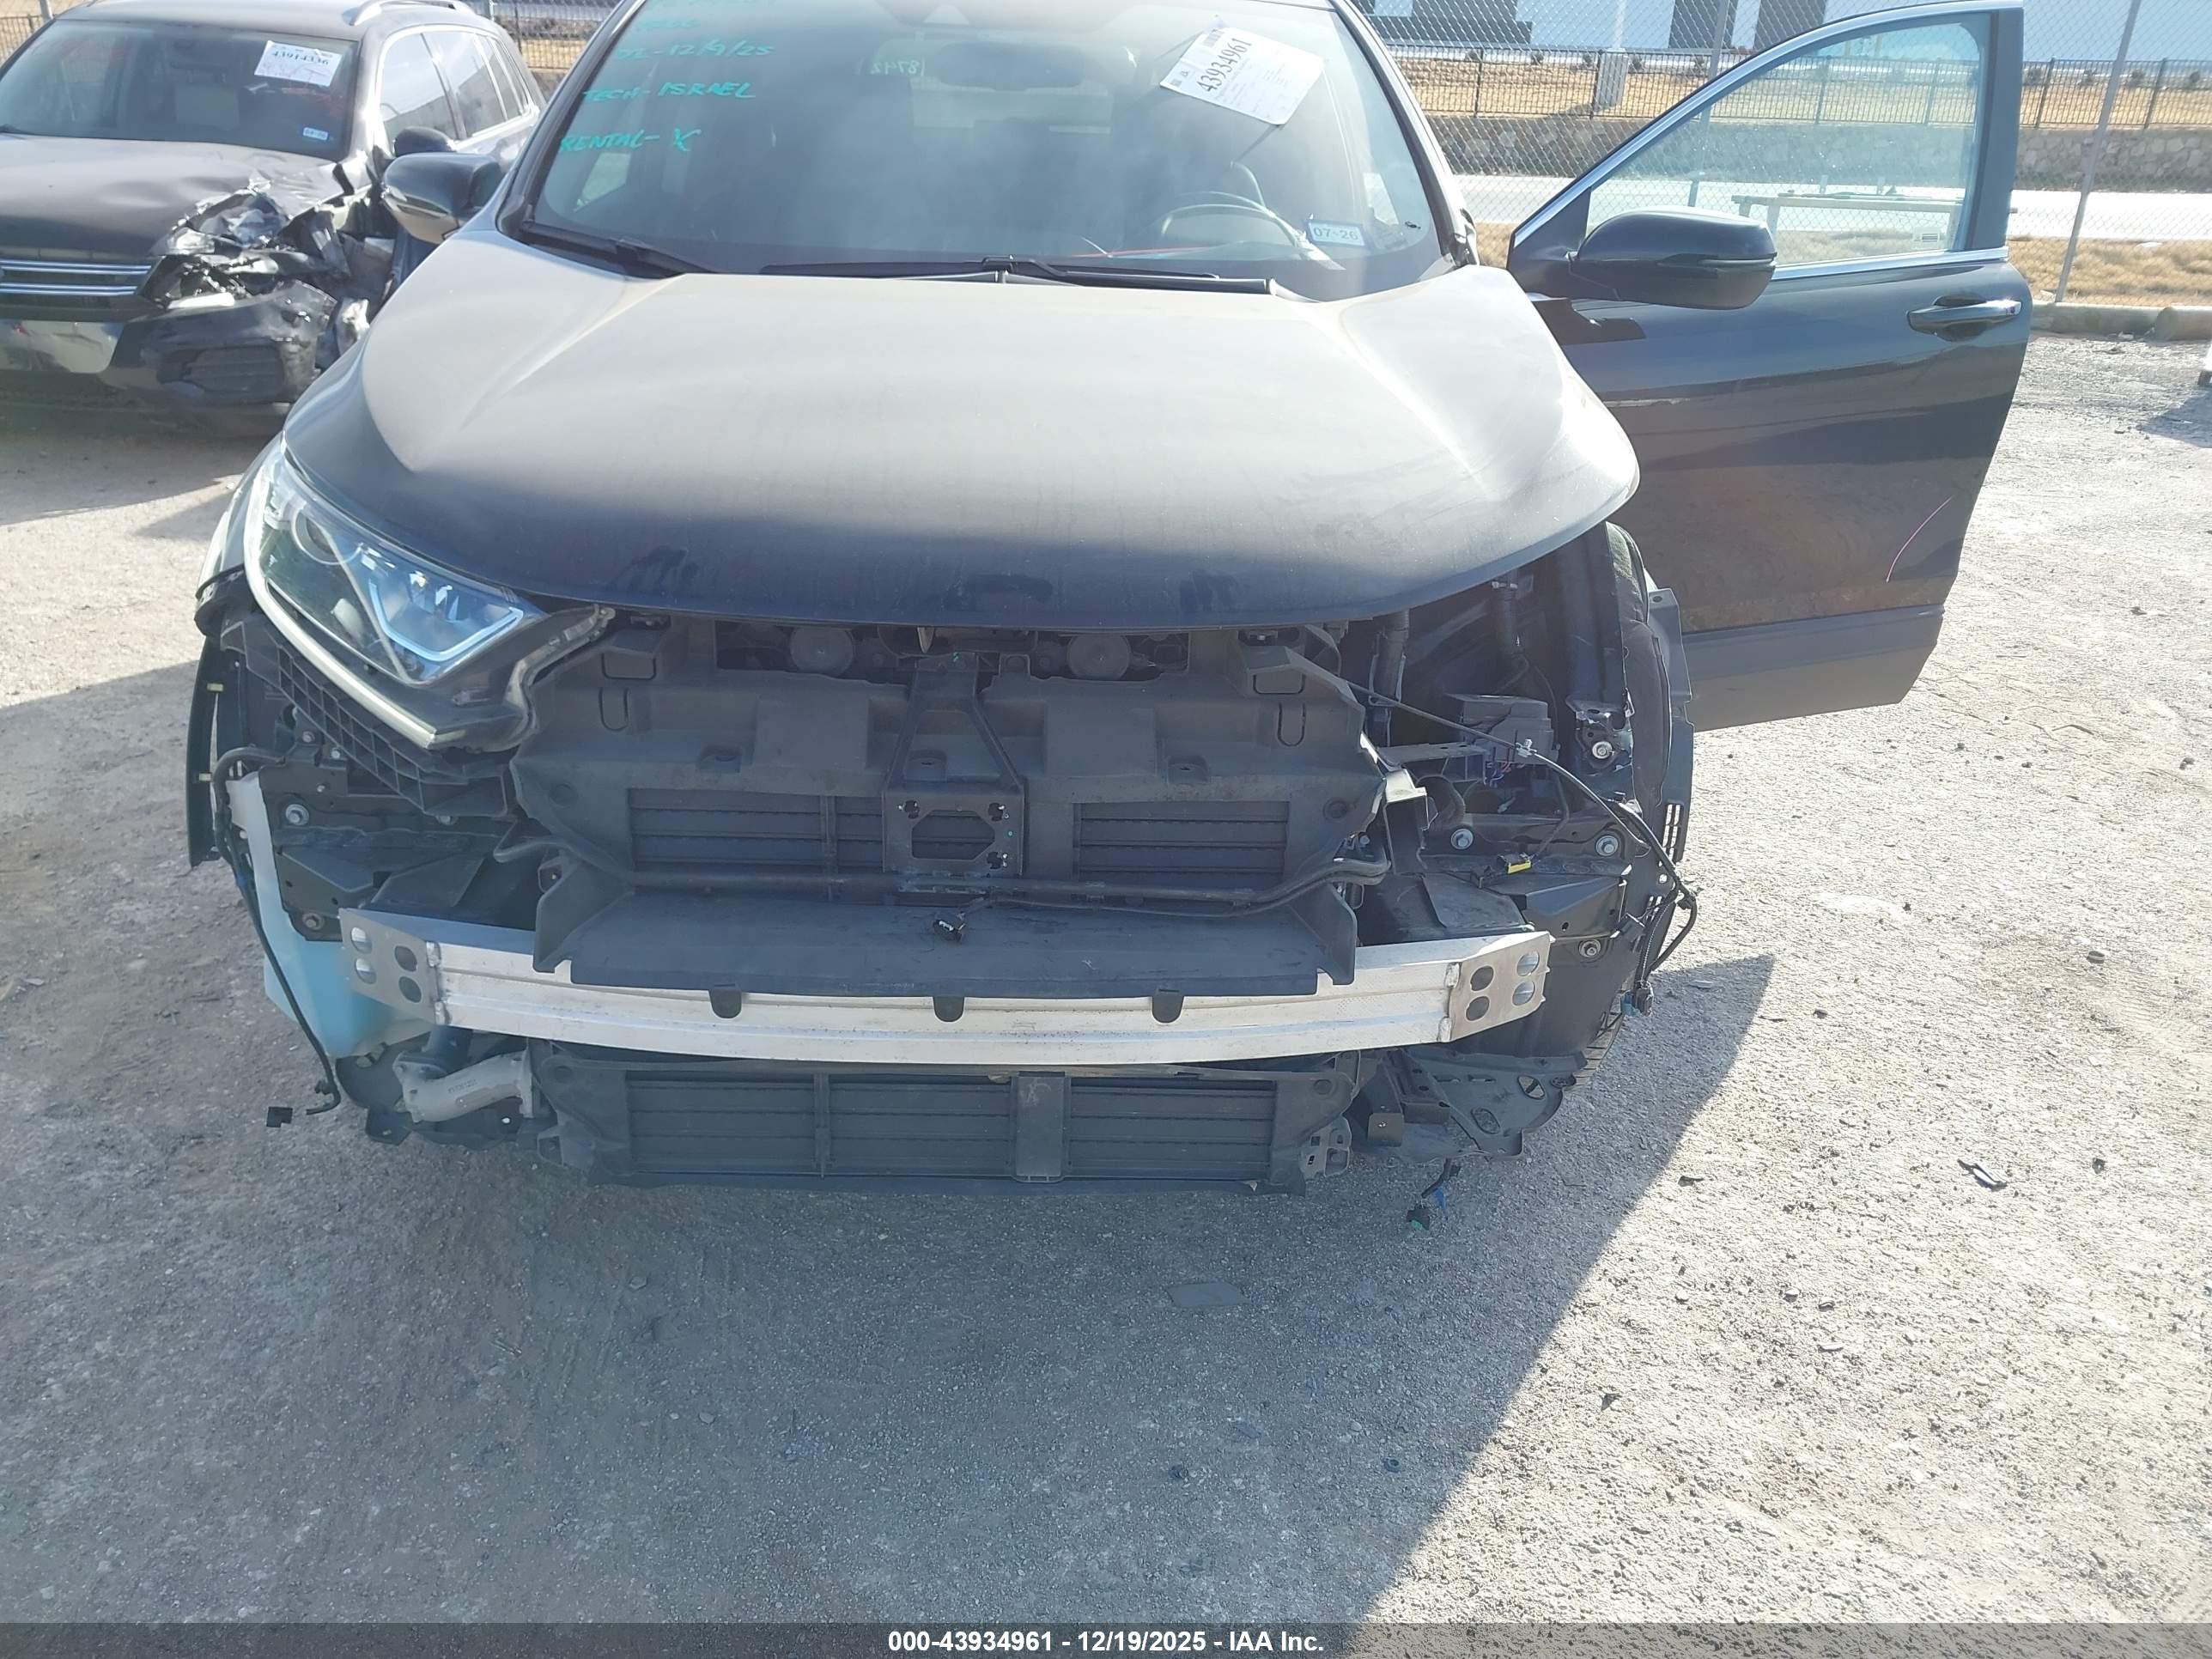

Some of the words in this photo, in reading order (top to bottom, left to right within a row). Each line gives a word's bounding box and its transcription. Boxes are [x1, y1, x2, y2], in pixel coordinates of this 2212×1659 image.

[1197, 37, 1253, 93] 43934961
[658, 82, 756, 98] ISRAEL
[1312, 226, 1359, 242] 07-26
